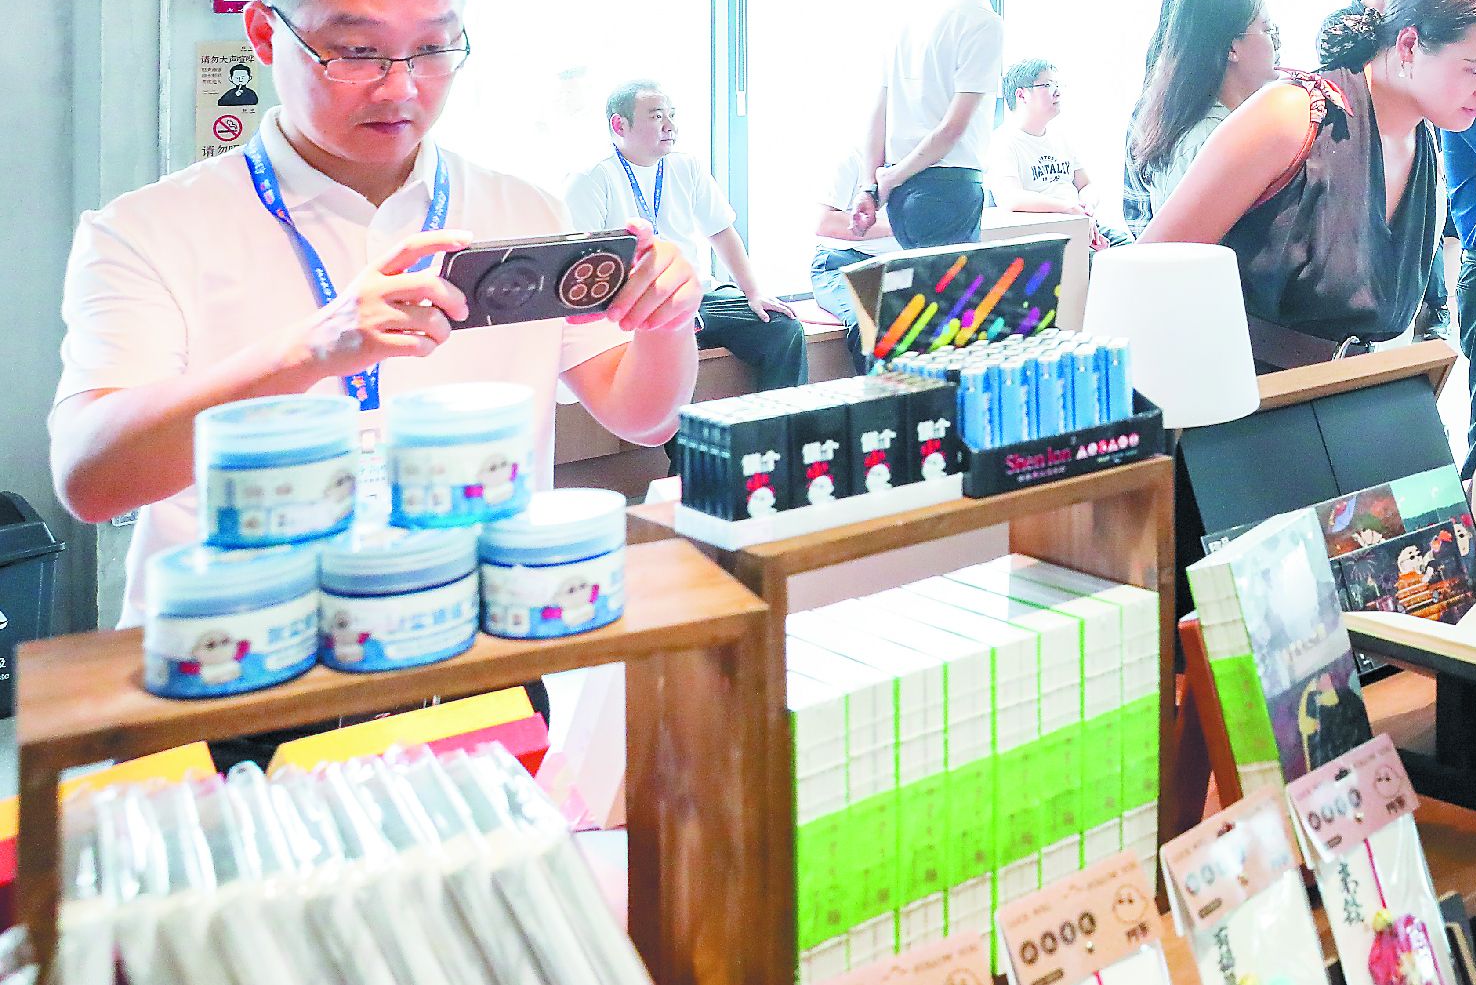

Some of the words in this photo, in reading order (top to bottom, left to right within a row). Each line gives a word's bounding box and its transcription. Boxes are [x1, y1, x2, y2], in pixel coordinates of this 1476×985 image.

[200, 54, 255, 65] 请勿大声喧哗
